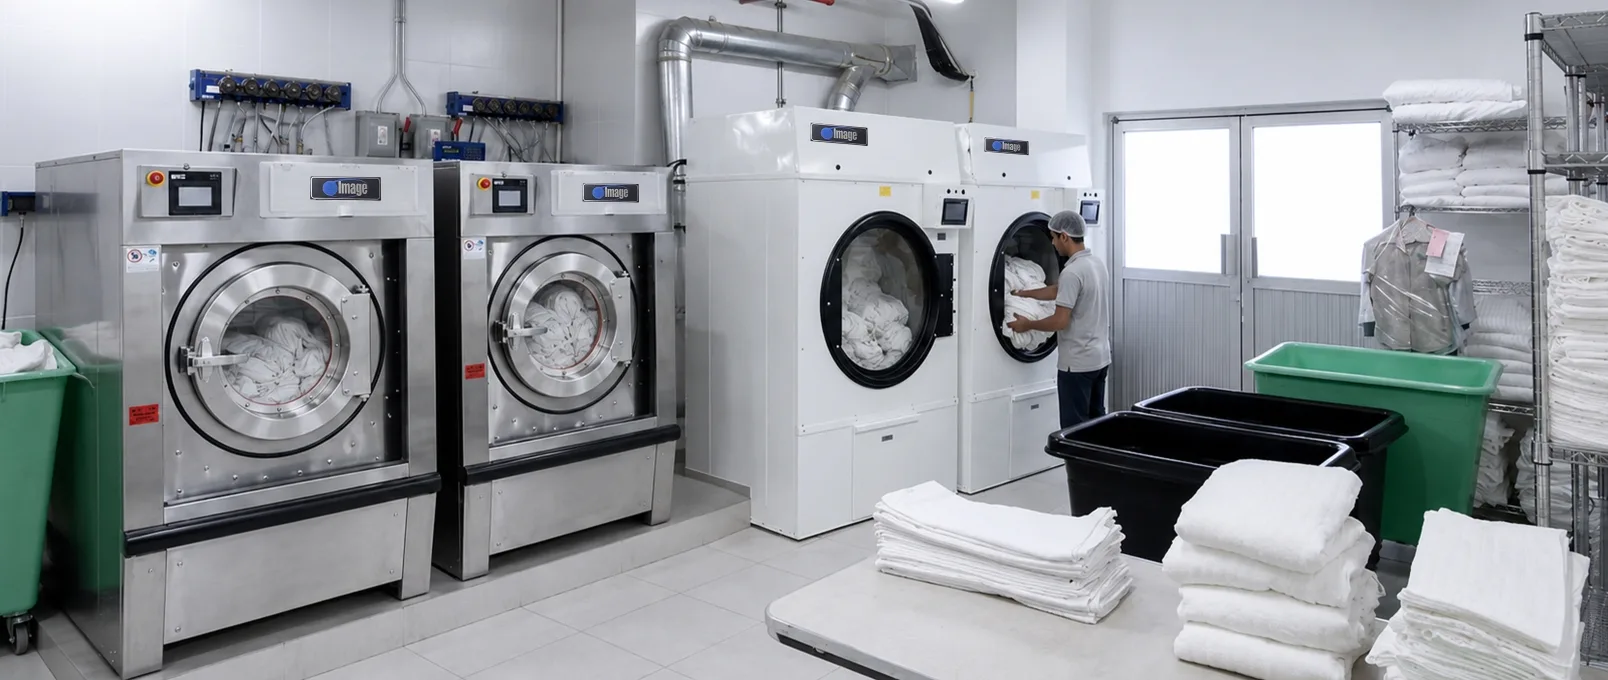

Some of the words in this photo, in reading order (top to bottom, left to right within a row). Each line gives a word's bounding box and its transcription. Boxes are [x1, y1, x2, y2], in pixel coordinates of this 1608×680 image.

[833, 127, 858, 141] Image
[338, 180, 368, 197] Image
[604, 186, 629, 199] Image
